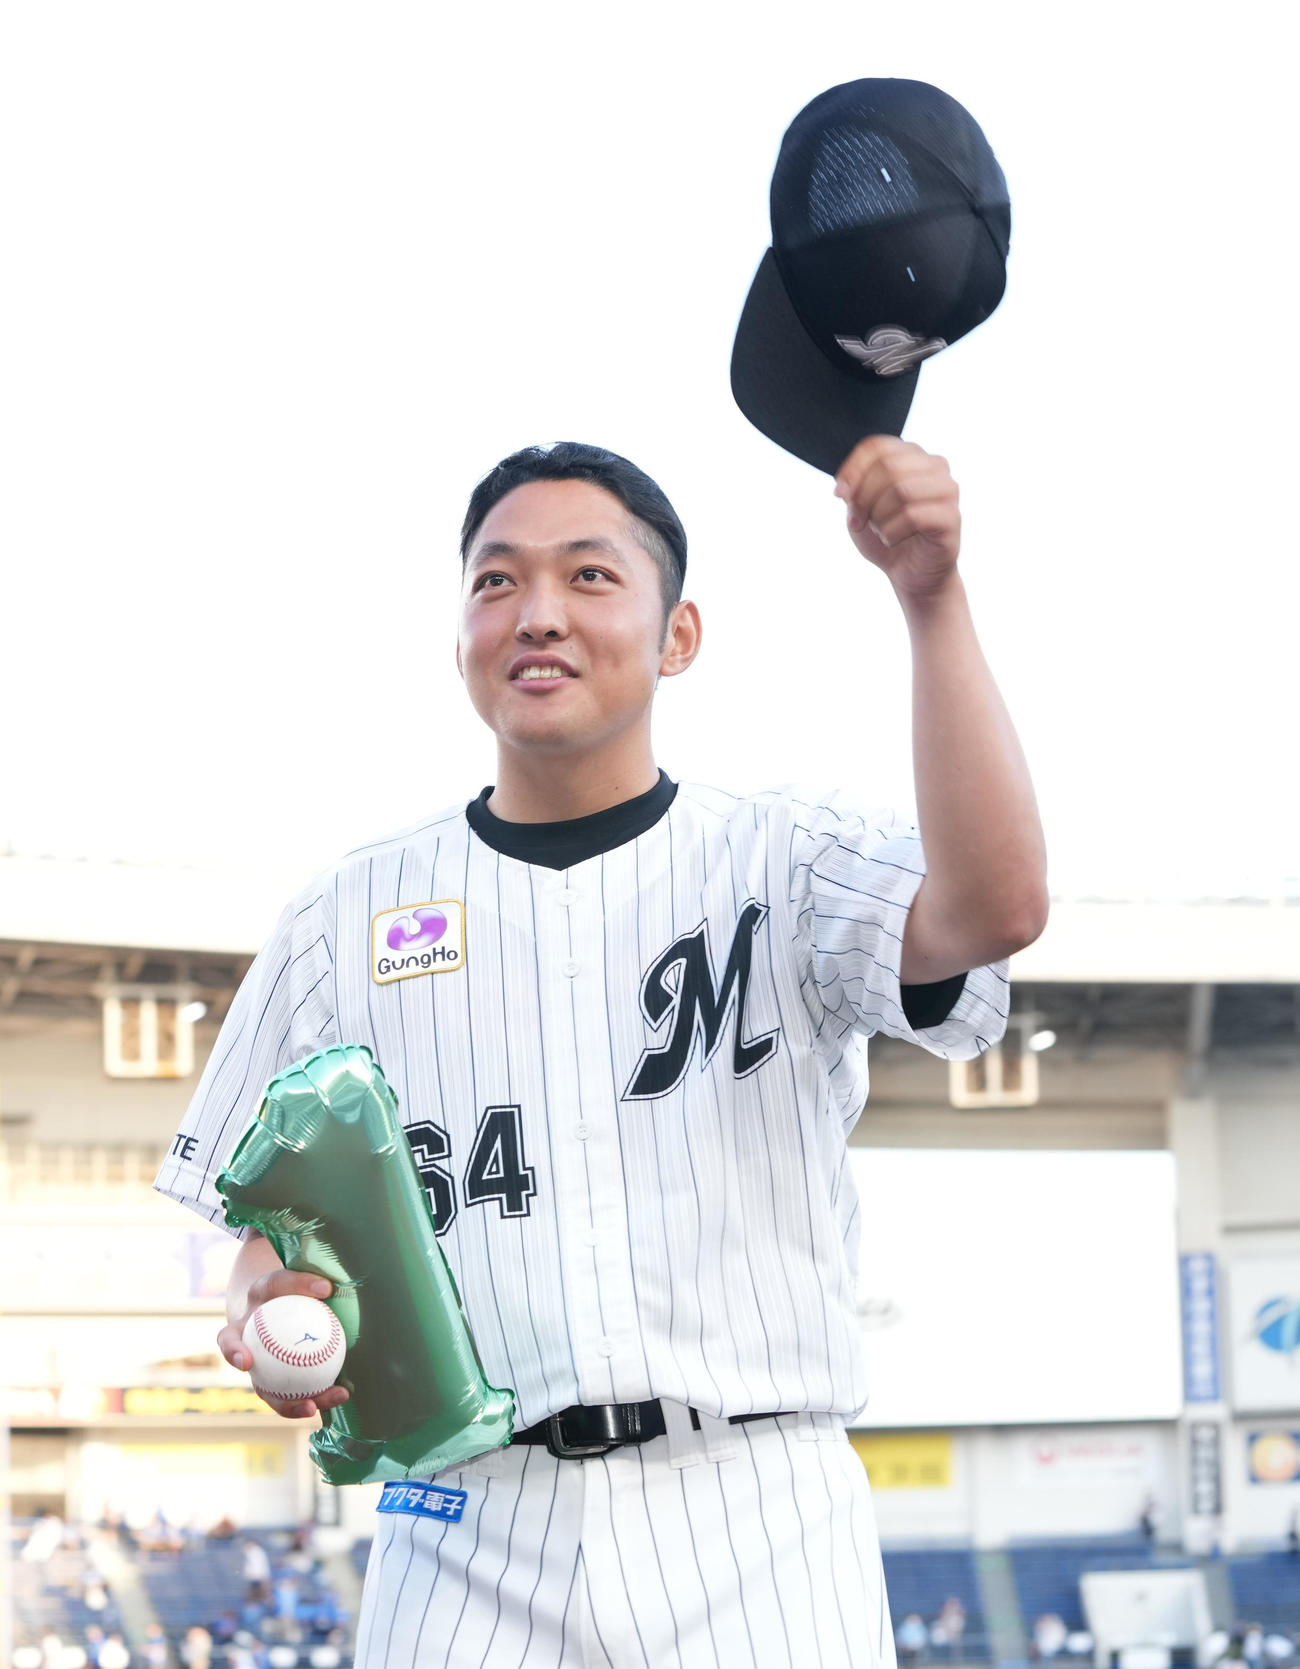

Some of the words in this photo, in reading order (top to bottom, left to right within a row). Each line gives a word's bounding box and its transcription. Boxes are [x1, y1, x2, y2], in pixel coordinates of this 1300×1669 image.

[377, 946, 459, 975] GungHo
[620, 897, 780, 1102] M
[403, 1104, 538, 1238] 64
